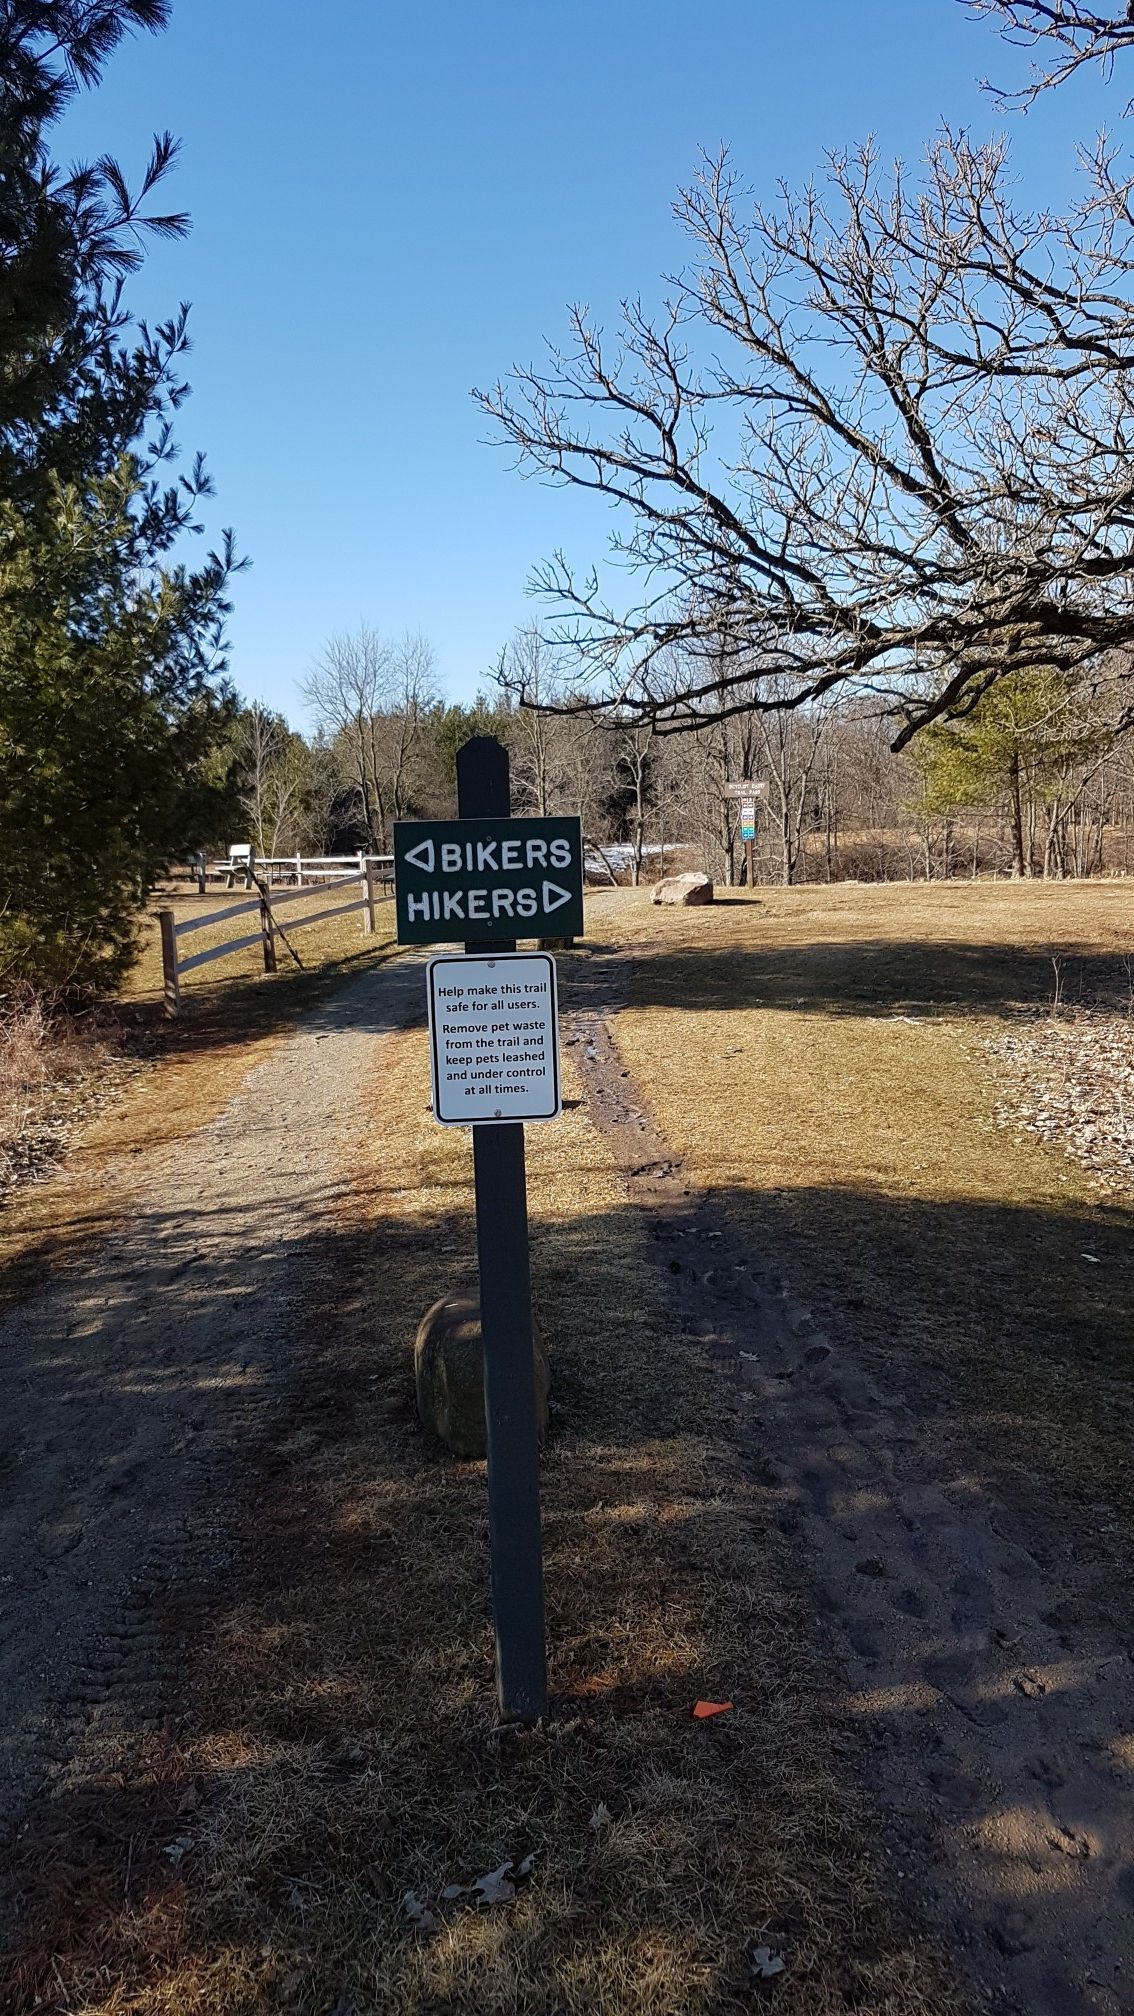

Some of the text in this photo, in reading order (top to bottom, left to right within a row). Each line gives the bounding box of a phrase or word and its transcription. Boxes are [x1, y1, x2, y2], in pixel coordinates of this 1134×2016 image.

[441, 839, 572, 872] BIKERS
[408, 888, 537, 922] HIKERS
[438, 983, 546, 998] Help make this trail
[446, 1000, 540, 1012] safe for all users.
[443, 1021, 545, 1033] Remove pet waste
[446, 1036, 544, 1049] from the trail and
[446, 1051, 544, 1066] keep pets leashed
[447, 1067, 545, 1080] and under control
[465, 1084, 528, 1095] at all times.
